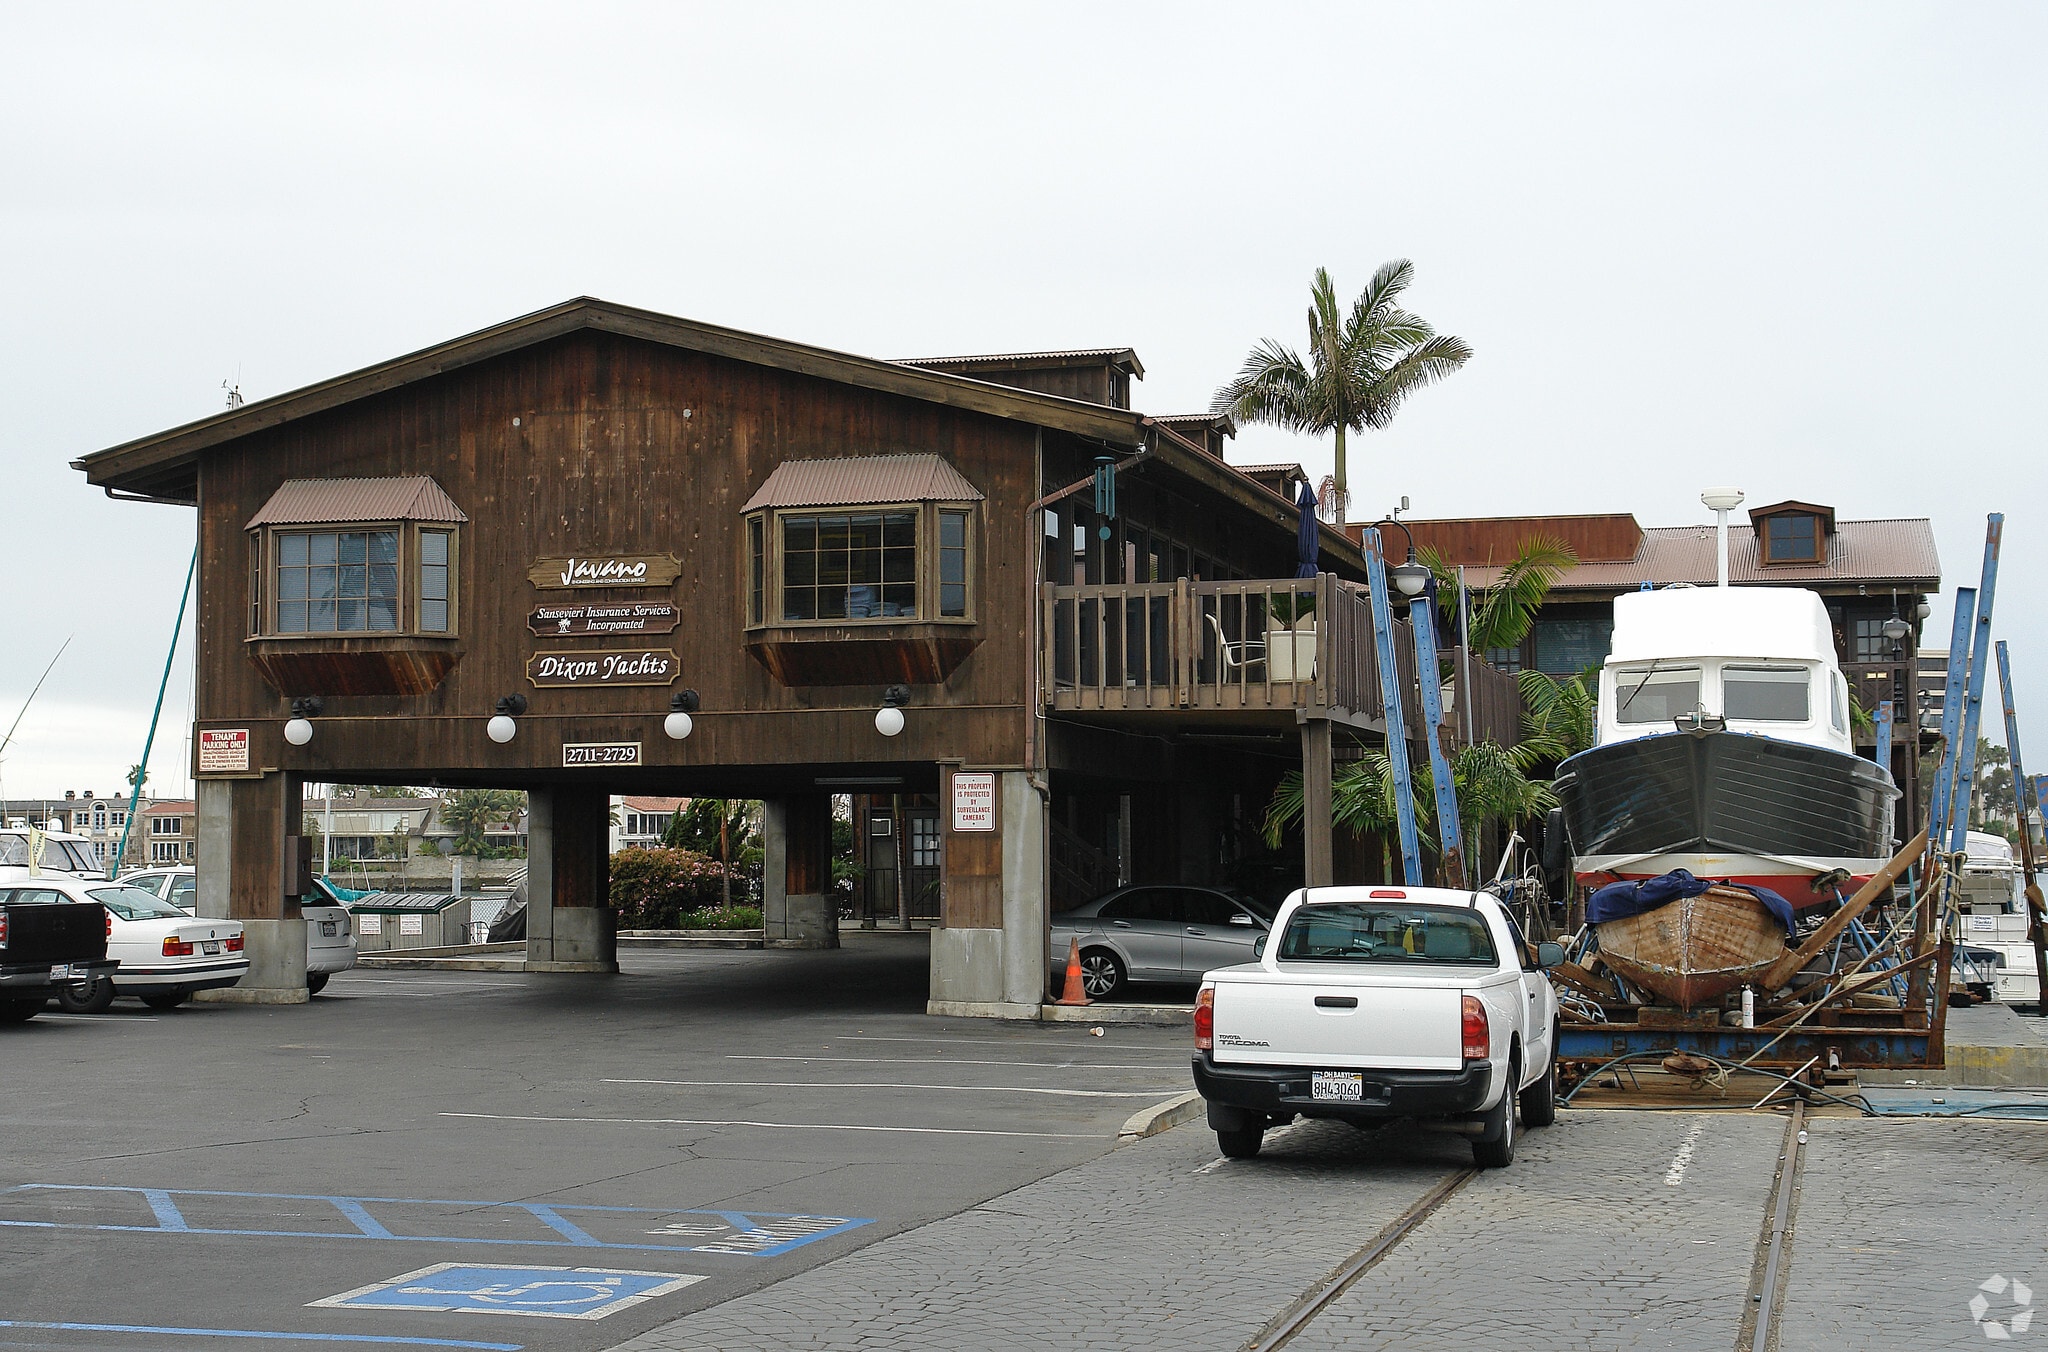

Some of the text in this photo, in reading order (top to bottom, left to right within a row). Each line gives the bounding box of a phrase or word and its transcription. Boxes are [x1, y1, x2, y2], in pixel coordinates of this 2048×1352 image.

[560, 557, 647, 586] Javano
[537, 604, 671, 619] Sansevieri Insurance Services
[586, 618, 645, 632] Incorporated
[538, 652, 669, 681] Dixon Yachts
[211, 733, 238, 741] TENANT
[203, 740, 246, 749] PARKING ONLY
[1219, 1039, 1271, 1047] TACOMA
[1314, 1081, 1360, 1096] 8H43060
